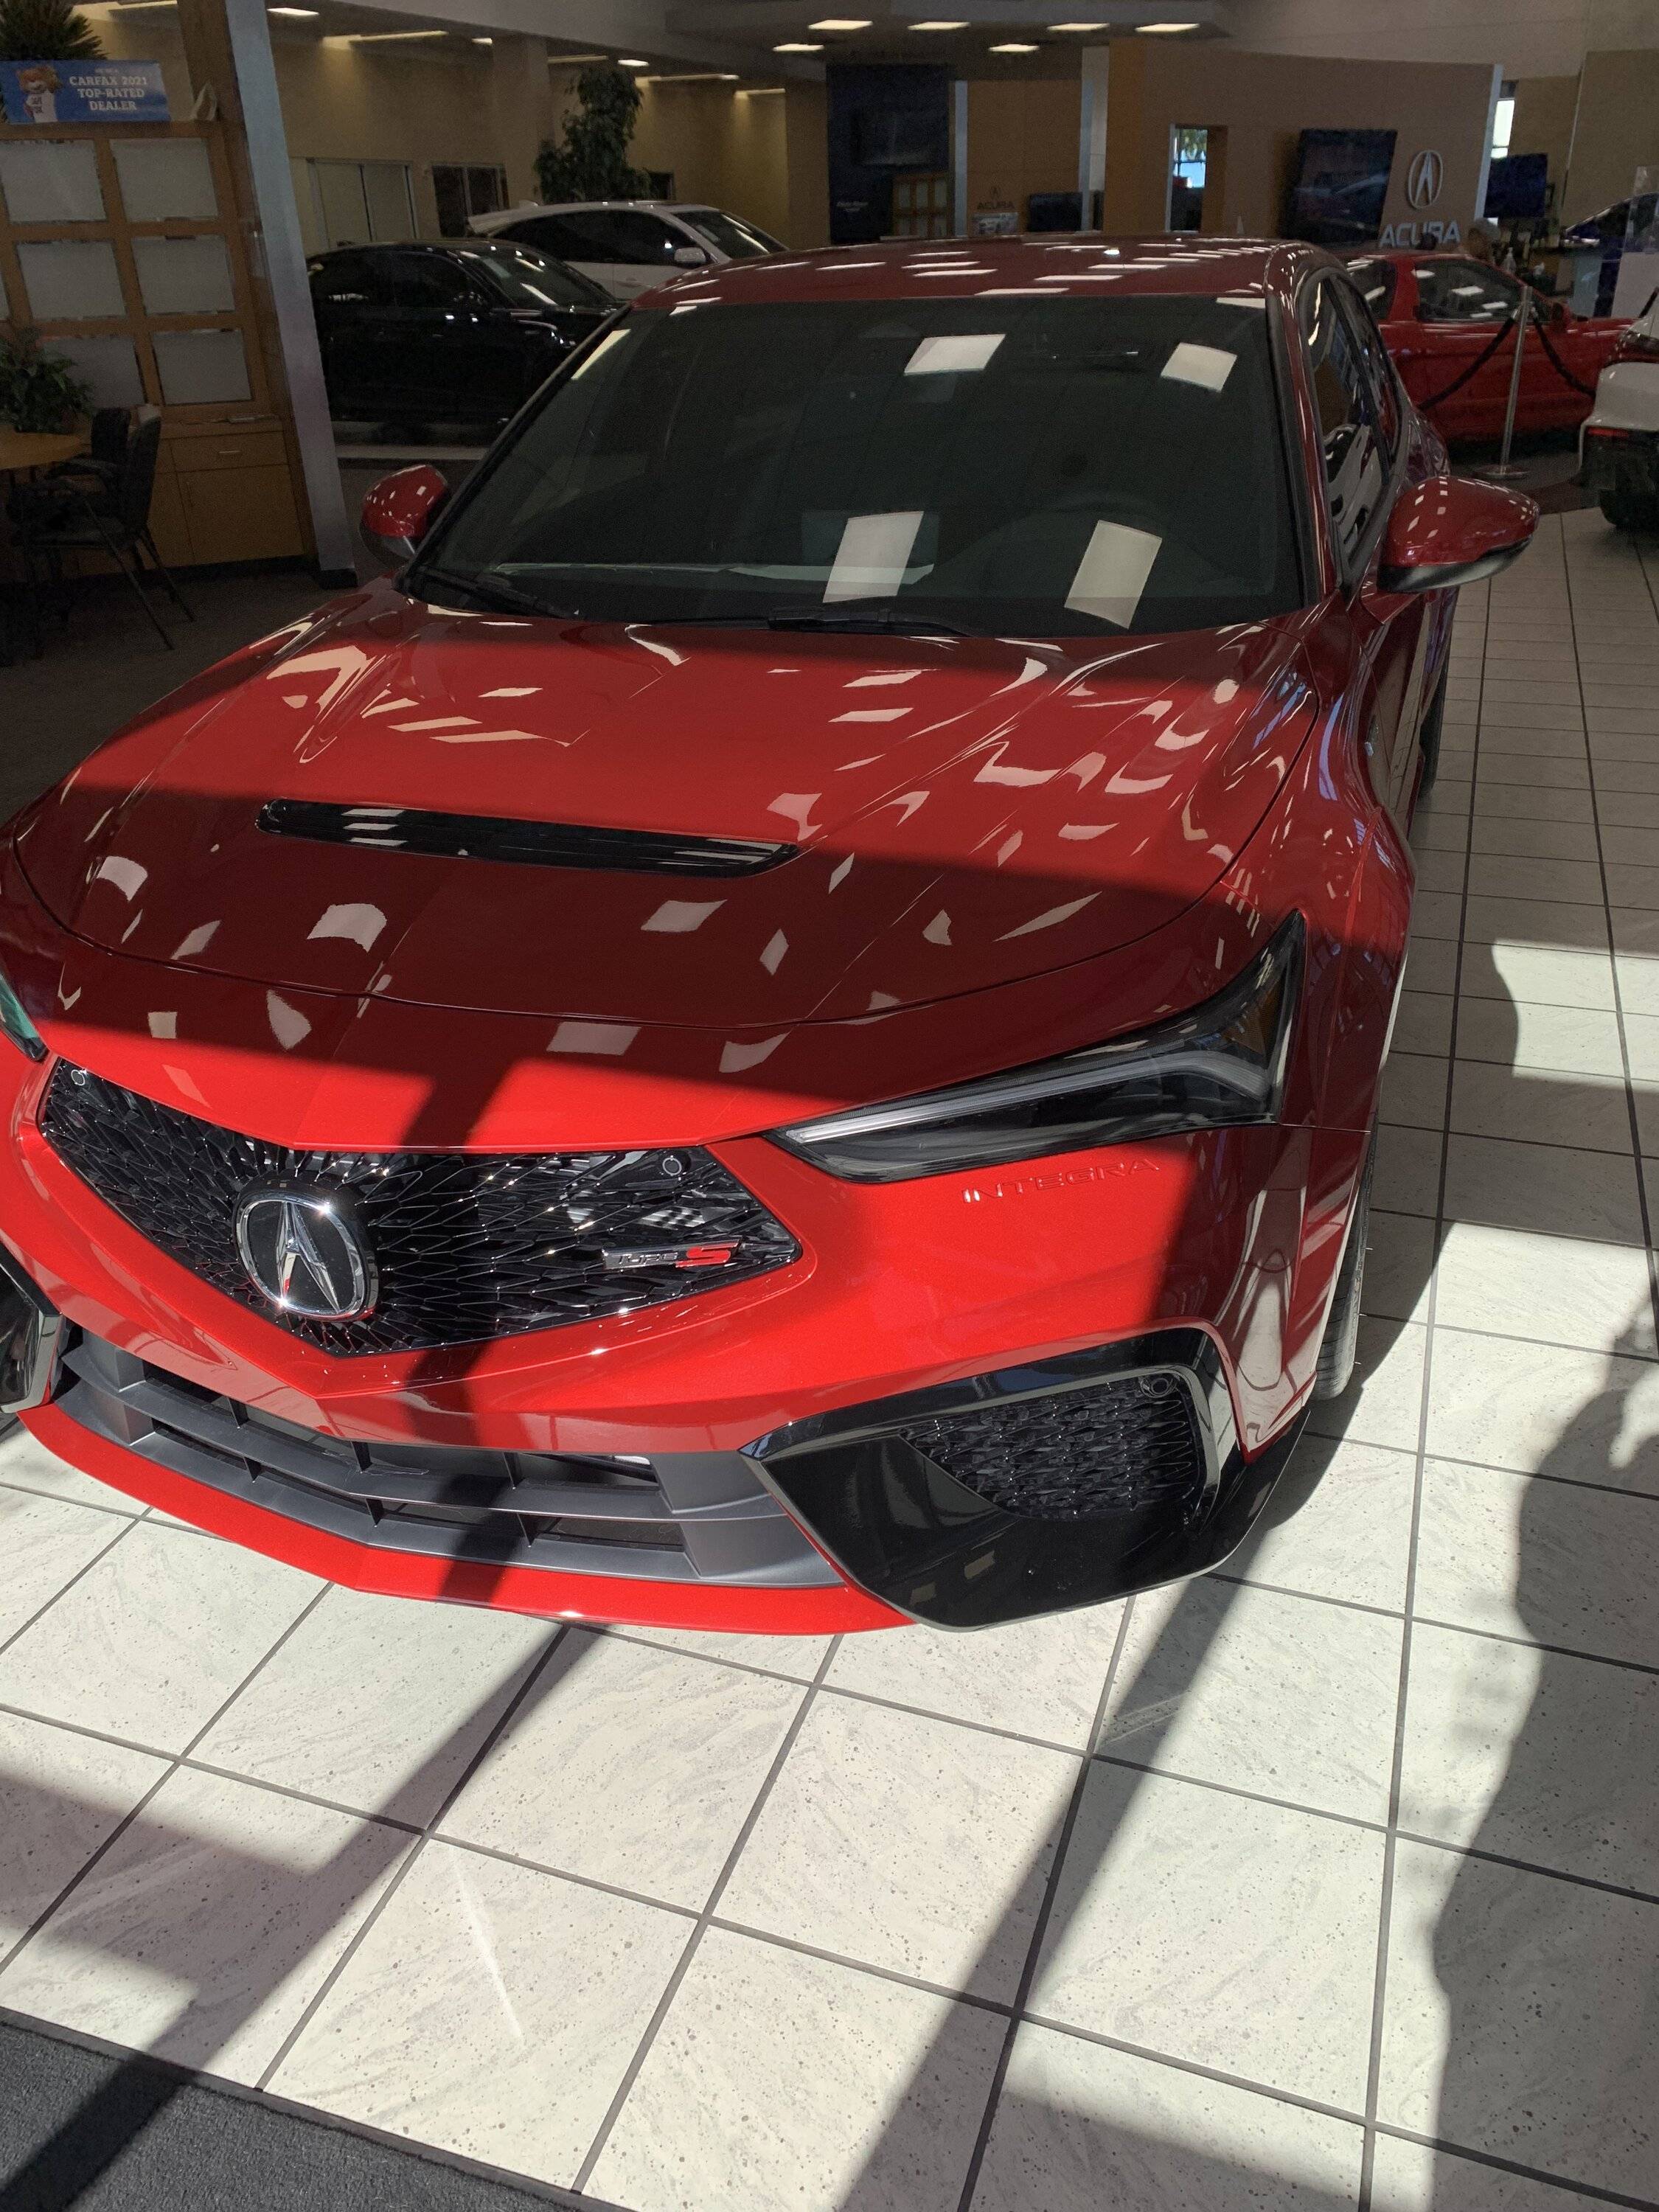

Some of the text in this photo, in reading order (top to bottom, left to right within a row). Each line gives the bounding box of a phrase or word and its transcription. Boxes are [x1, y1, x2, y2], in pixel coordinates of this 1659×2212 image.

[69, 76, 147, 86] CARFAX 2021
[77, 88, 145, 98] TOP-RATED
[88, 100, 137, 111] DEALER
[1379, 219, 1461, 248] ACURA
[961, 1158, 1160, 1203] INTEGRA
[675, 1239, 739, 1268] S
